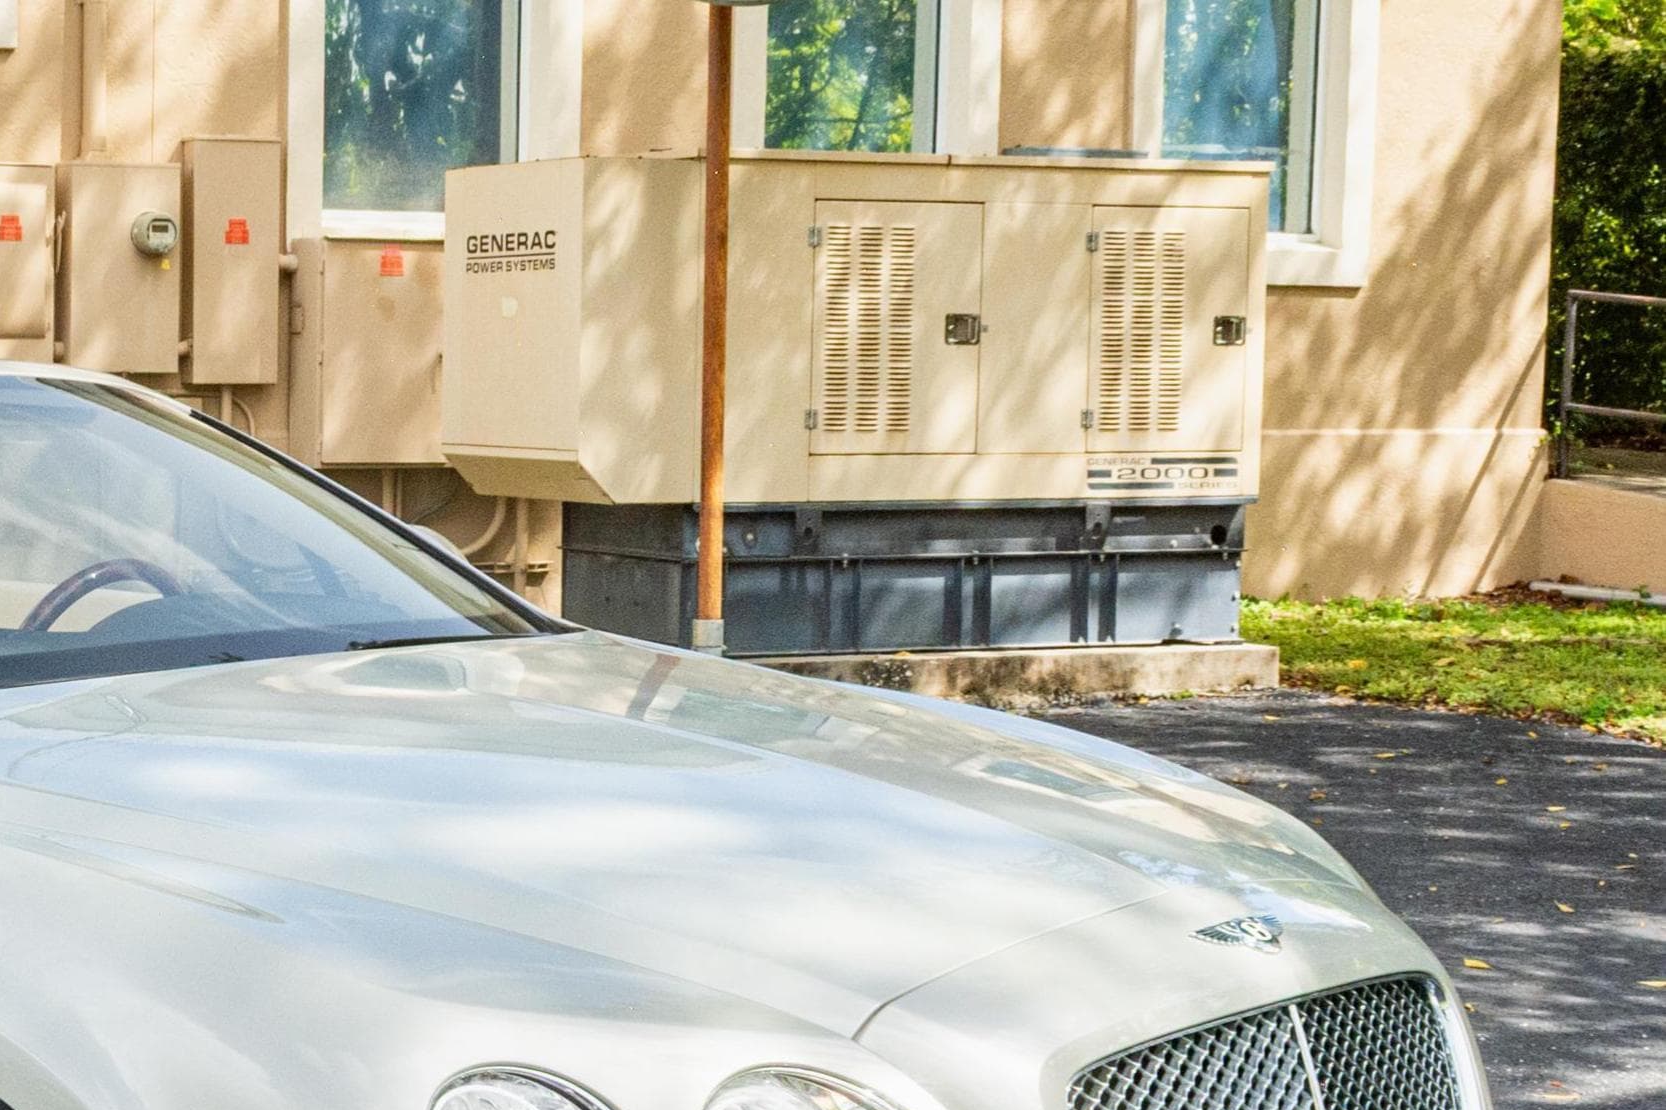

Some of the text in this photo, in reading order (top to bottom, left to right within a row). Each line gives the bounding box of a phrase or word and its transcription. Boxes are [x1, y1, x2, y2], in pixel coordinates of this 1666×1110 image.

[466, 230, 556, 254] GENERAC
[466, 258, 556, 274] POWER SYSTEMS
[1087, 457, 1146, 466] GENERAC
[1117, 467, 1208, 480] 2000
